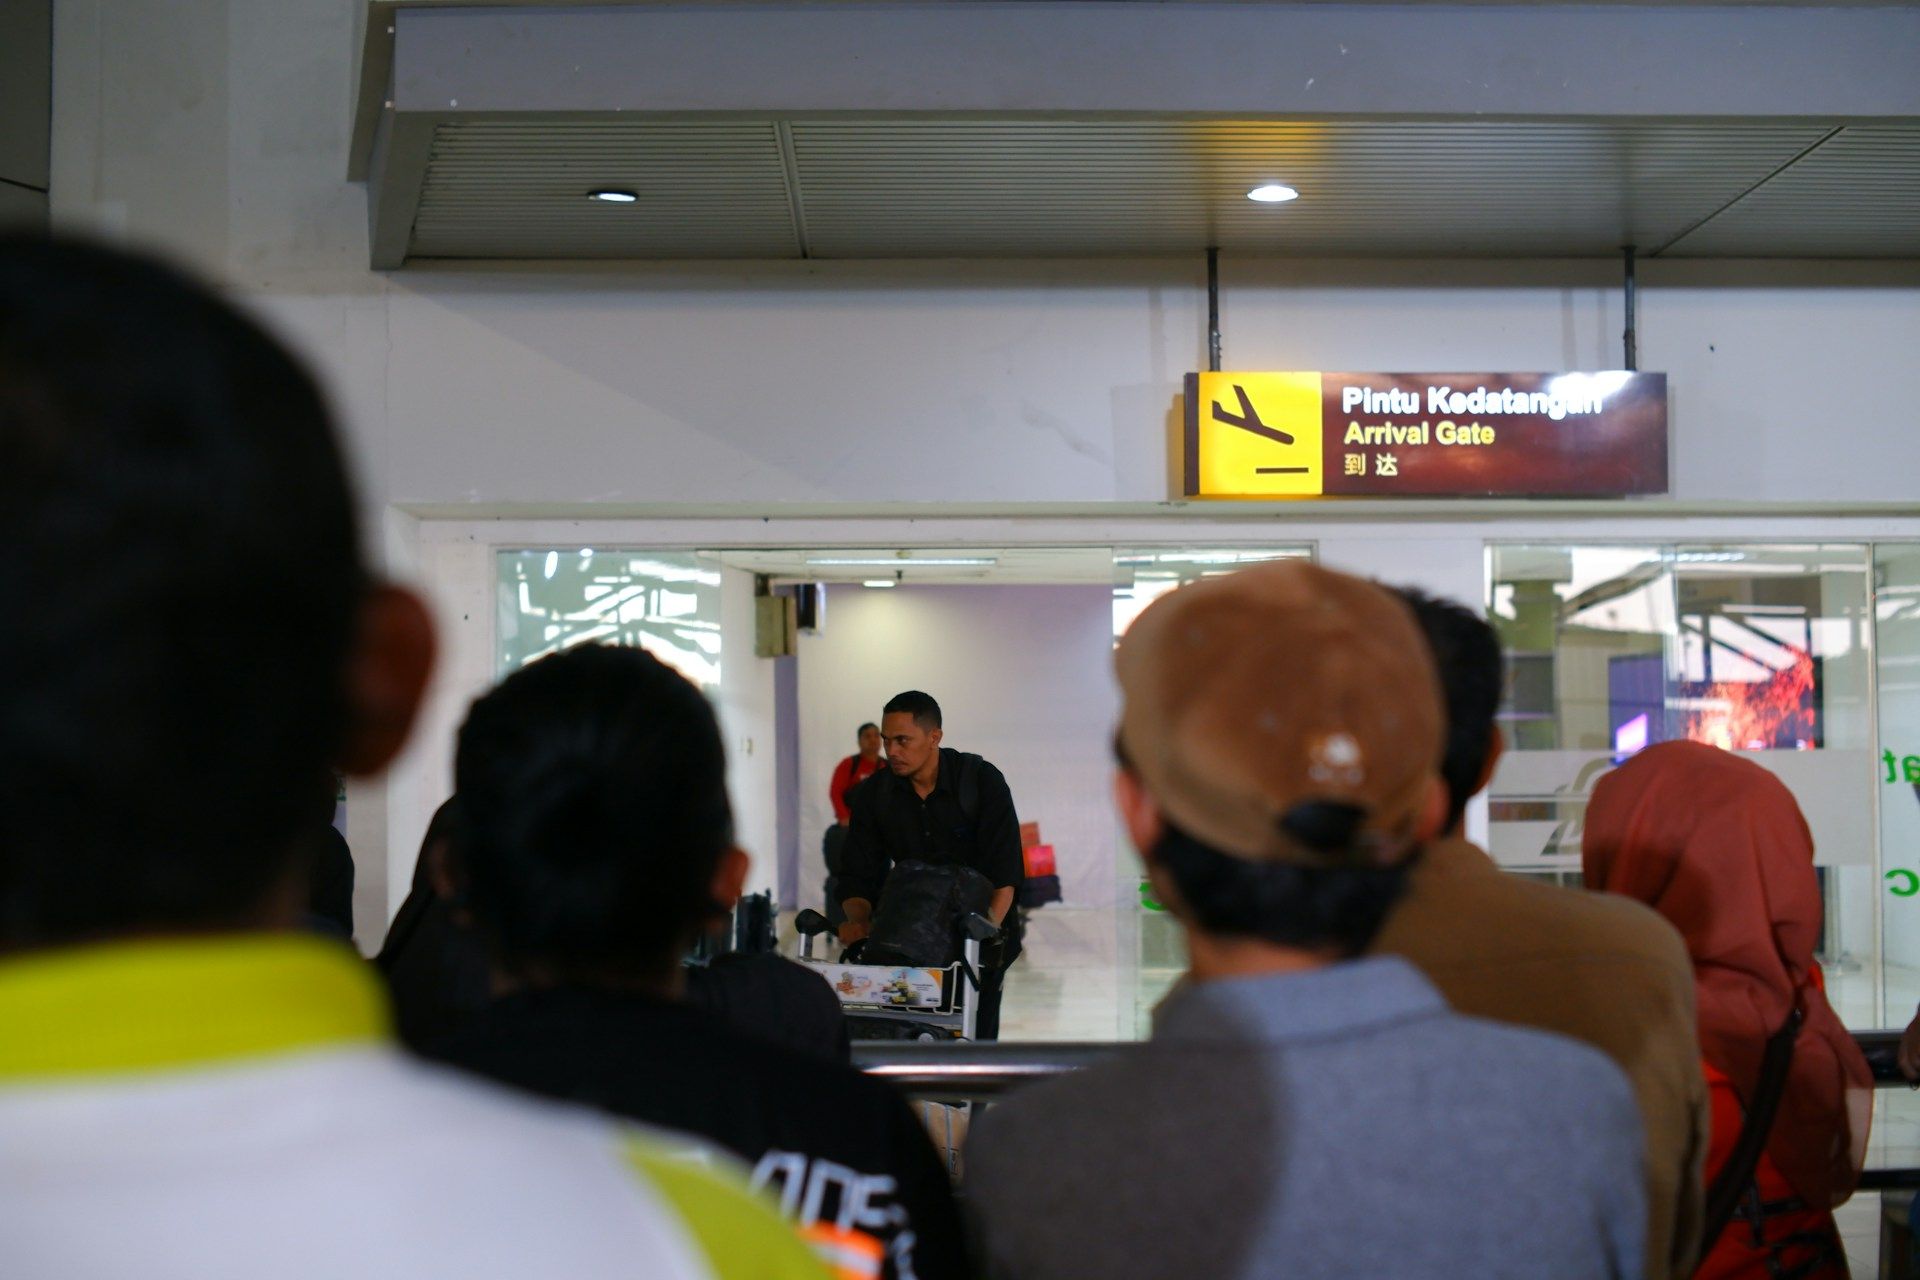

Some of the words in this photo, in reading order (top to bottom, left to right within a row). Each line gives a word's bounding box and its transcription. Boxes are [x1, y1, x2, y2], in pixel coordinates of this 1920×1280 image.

[1342, 386, 1420, 414] Pintu
[1344, 420, 1429, 445] Arrival
[1435, 420, 1495, 445] Gate
